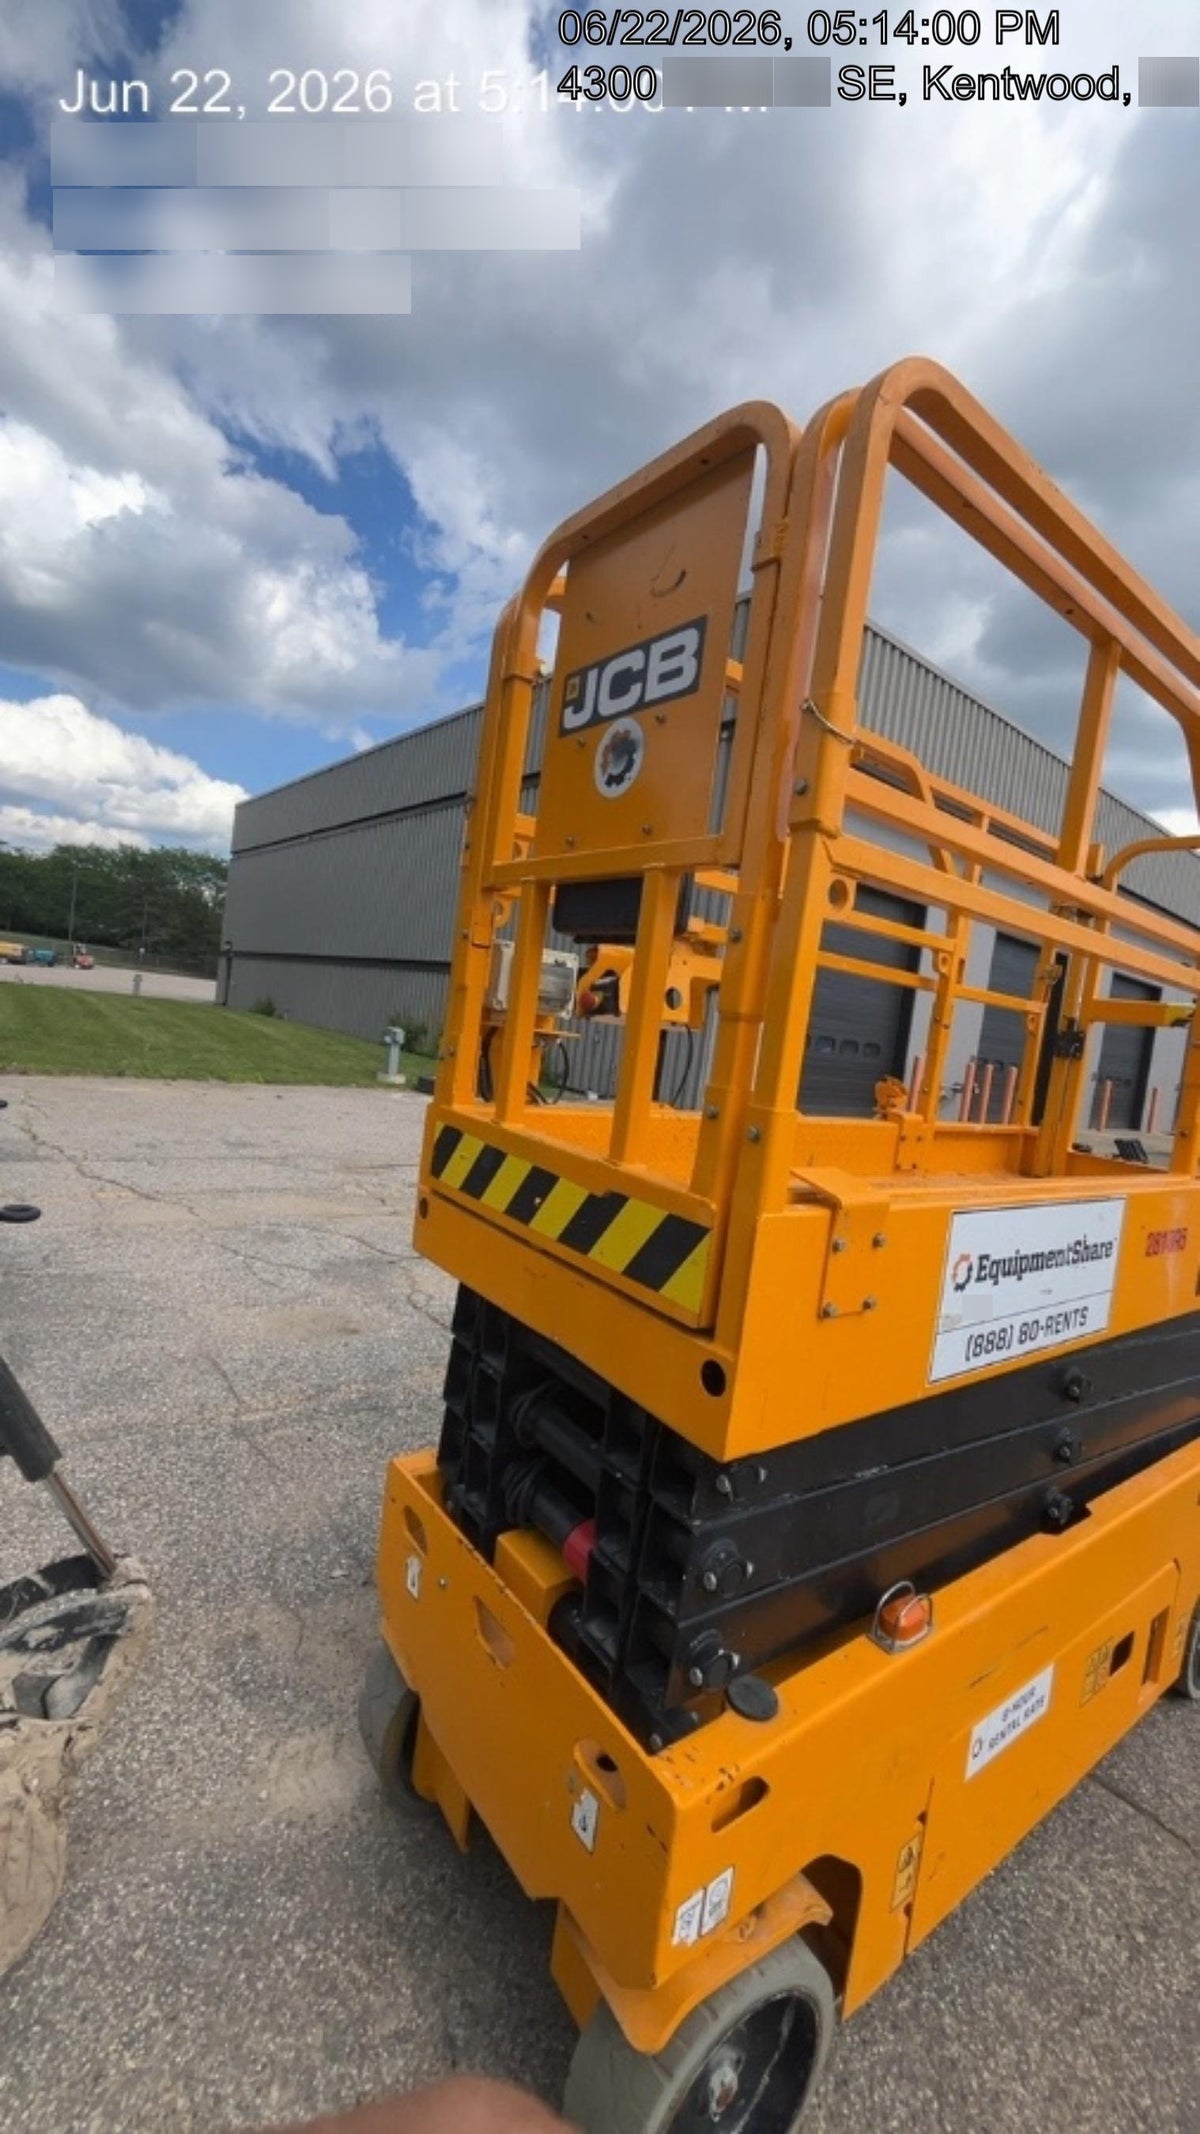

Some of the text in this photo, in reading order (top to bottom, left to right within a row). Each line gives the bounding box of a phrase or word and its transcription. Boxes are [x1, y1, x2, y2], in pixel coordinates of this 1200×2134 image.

[563, 627, 700, 730] JCB
[974, 1235, 1114, 1287] EquipmentShare
[964, 1306, 1089, 1362] (888) 80-RENTS
